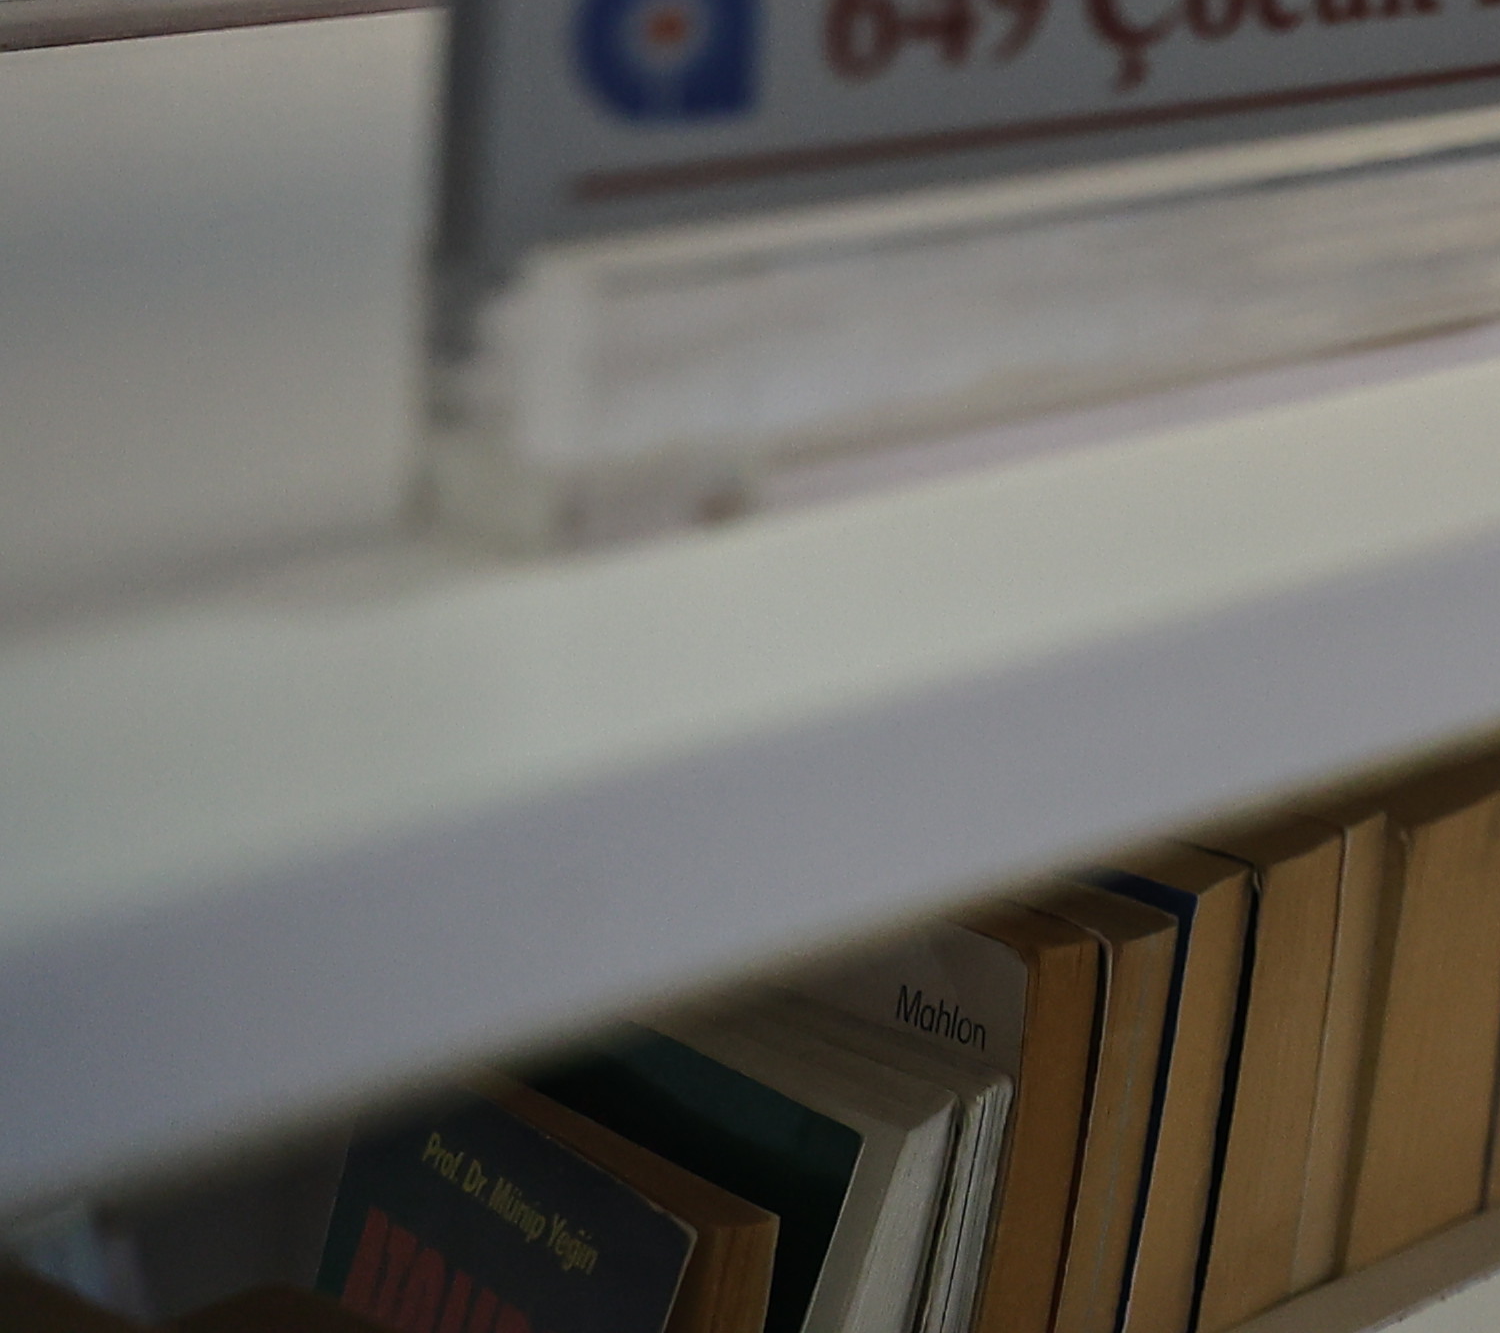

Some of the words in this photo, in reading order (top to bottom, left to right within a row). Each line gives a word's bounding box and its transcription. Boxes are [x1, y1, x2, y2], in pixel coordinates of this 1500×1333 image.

[895, 984, 986, 1053] Mahlon
[422, 1132, 465, 1182] Prof.
[461, 1159, 488, 1203] Dr.
